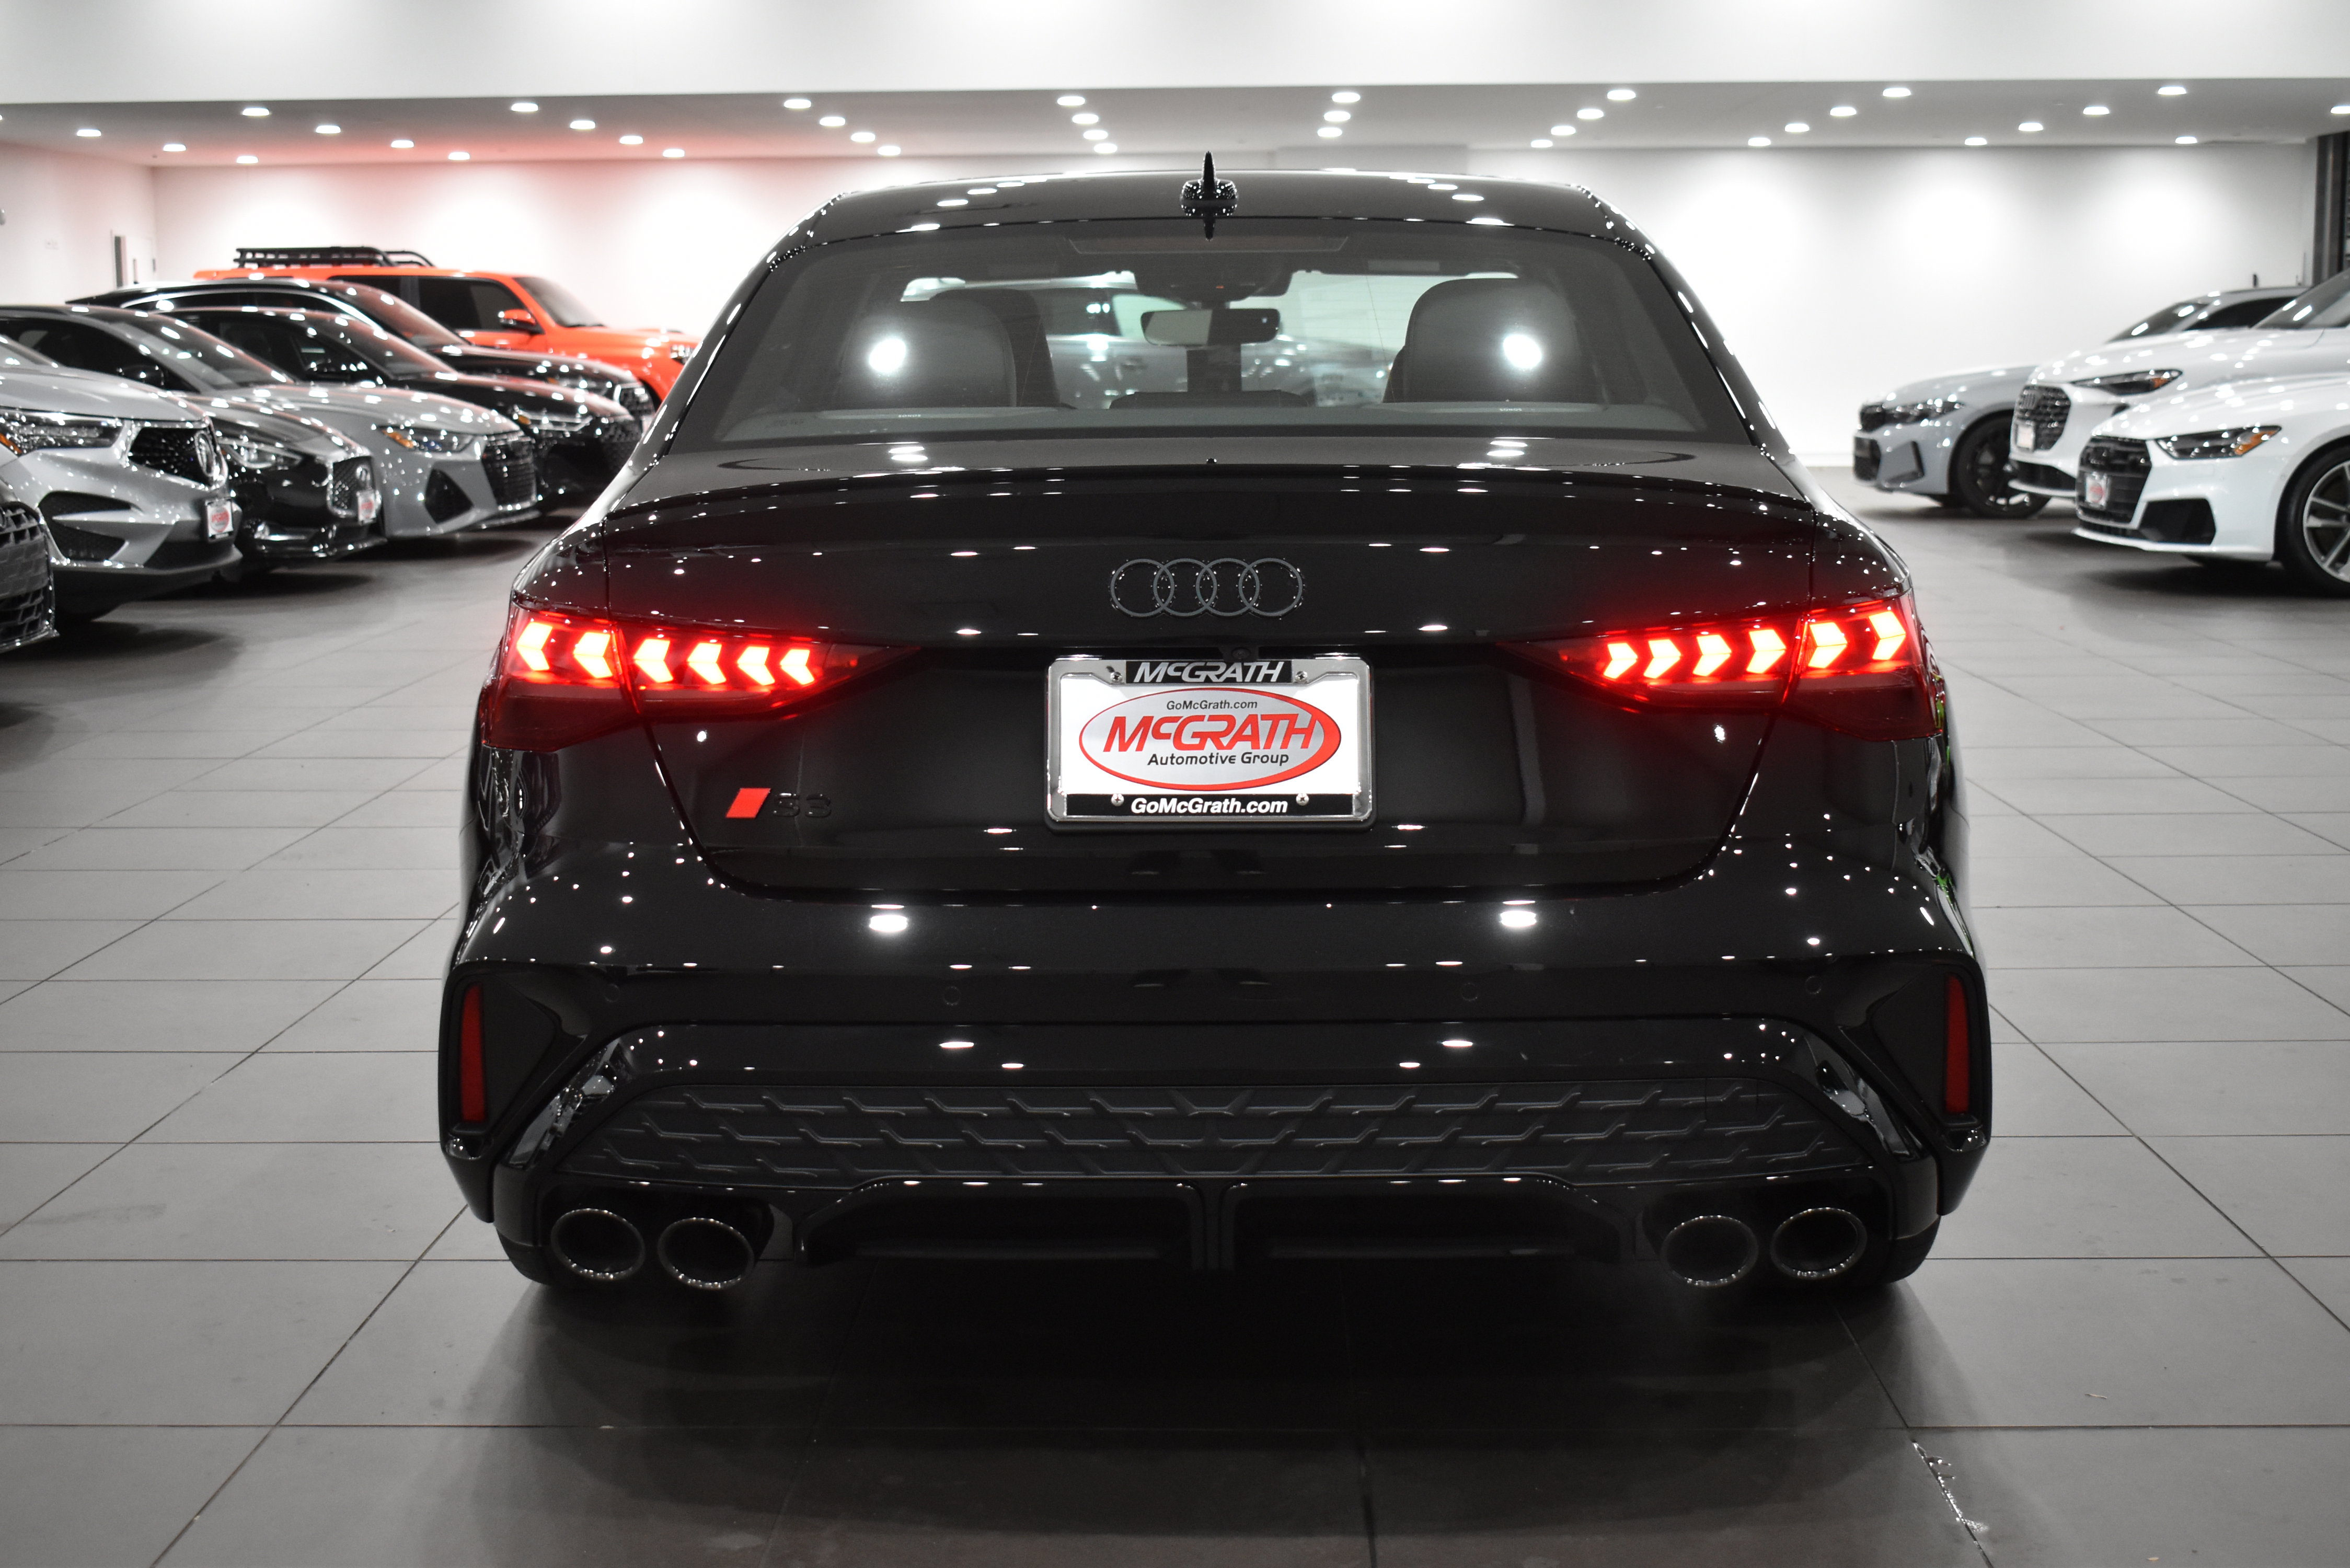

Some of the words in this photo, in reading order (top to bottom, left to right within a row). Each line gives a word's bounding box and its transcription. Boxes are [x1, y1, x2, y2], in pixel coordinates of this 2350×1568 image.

[1166, 699, 1258, 711] GoMcGrath.com
[1147, 752, 1236, 766] Automotive
[1240, 752, 1289, 767] Group
[773, 792, 832, 818] S3
[1131, 797, 1288, 814] GoMcGrath.com
